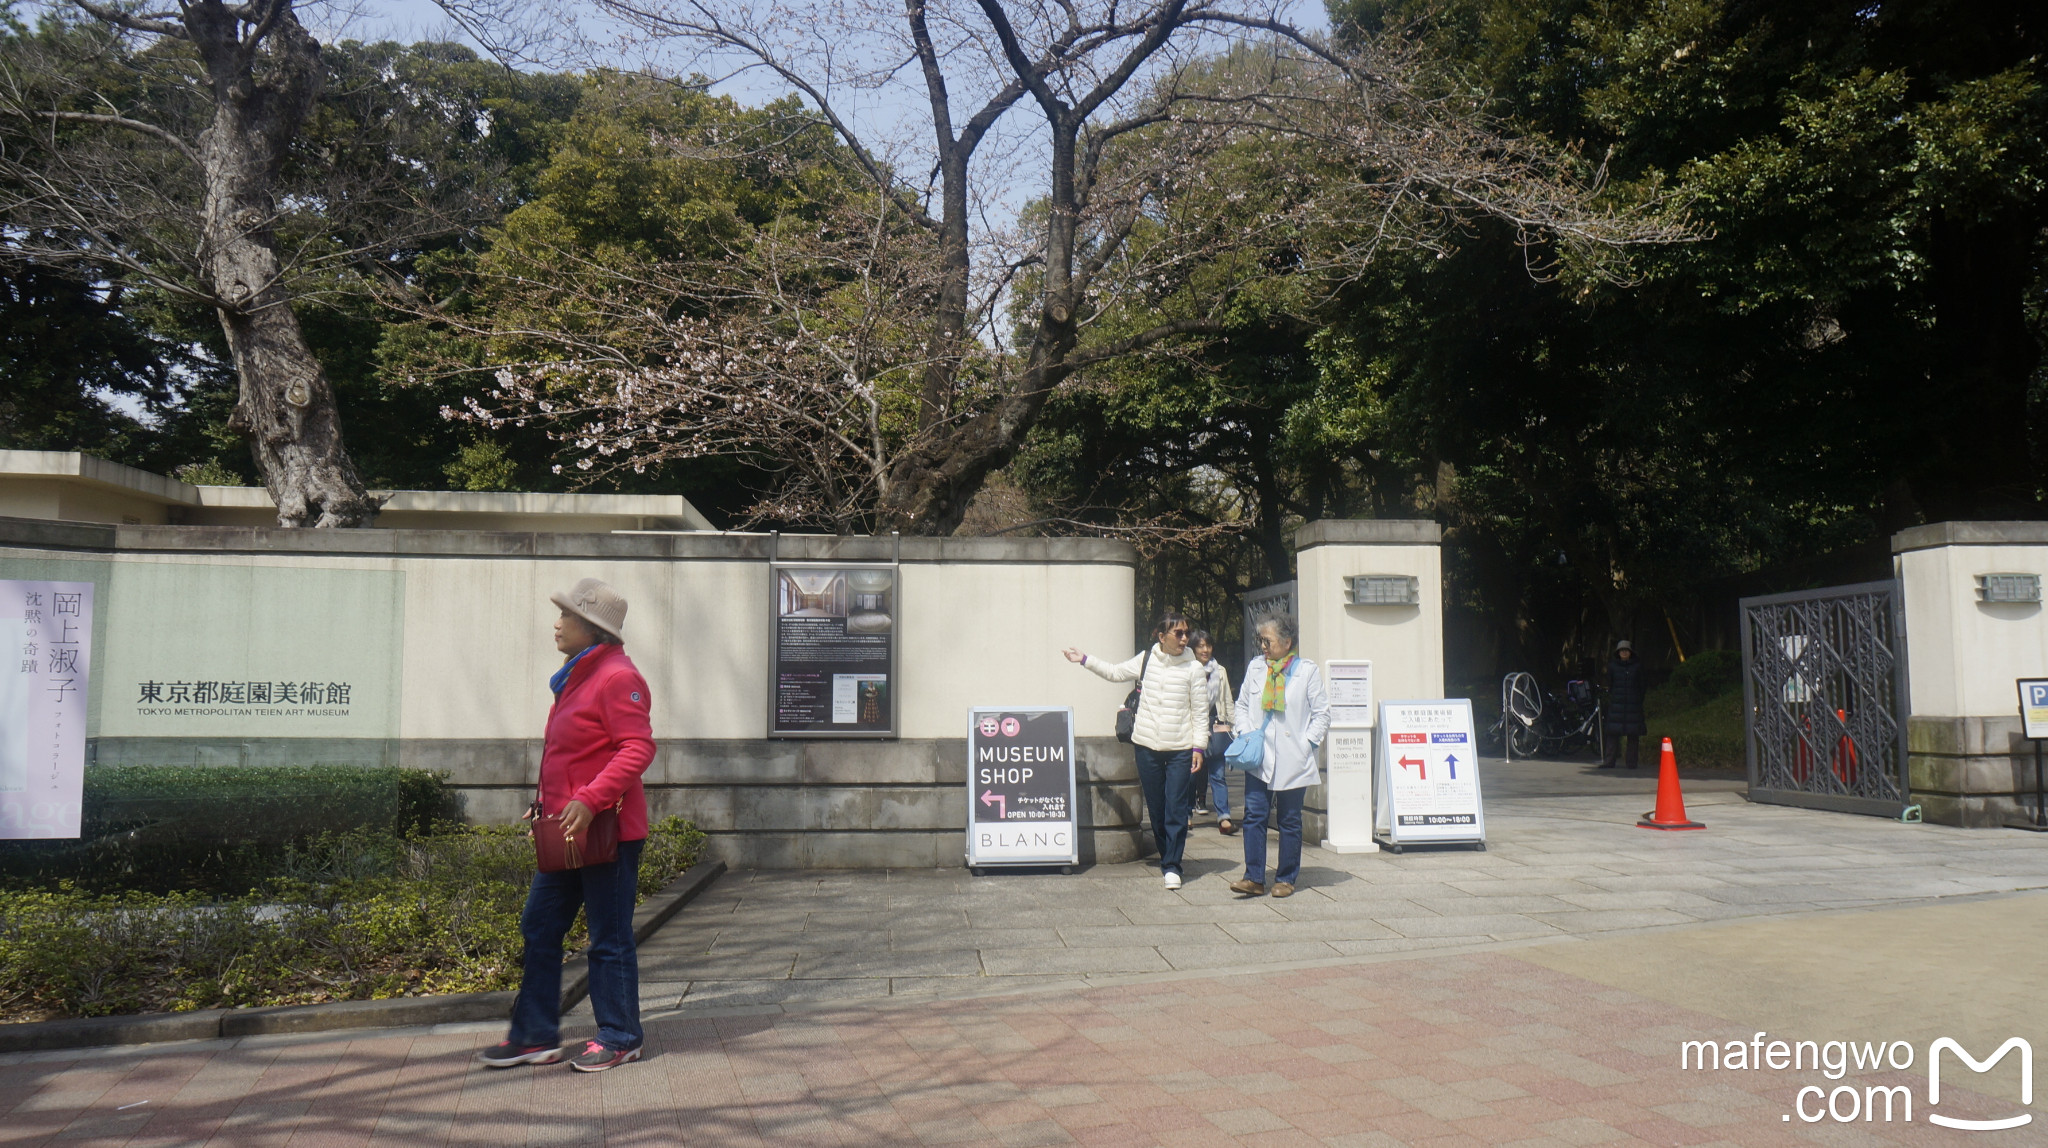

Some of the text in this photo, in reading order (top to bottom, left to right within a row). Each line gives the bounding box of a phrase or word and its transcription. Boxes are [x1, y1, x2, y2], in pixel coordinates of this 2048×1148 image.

[20, 591, 43, 675] 沈黙の奇蹟
[47, 591, 82, 704] 岡上淑子
[136, 680, 352, 705] 東京都庭園美術館
[2033, 687, 2047, 705] P
[137, 708, 350, 716] TOKYO METROPOLITAN TEIEN ART MUSEUM
[980, 746, 1064, 763] MUSEUM
[980, 768, 1034, 785] SHOP
[1007, 811, 1027, 819] OPEN
[981, 832, 1066, 848] BLANC
